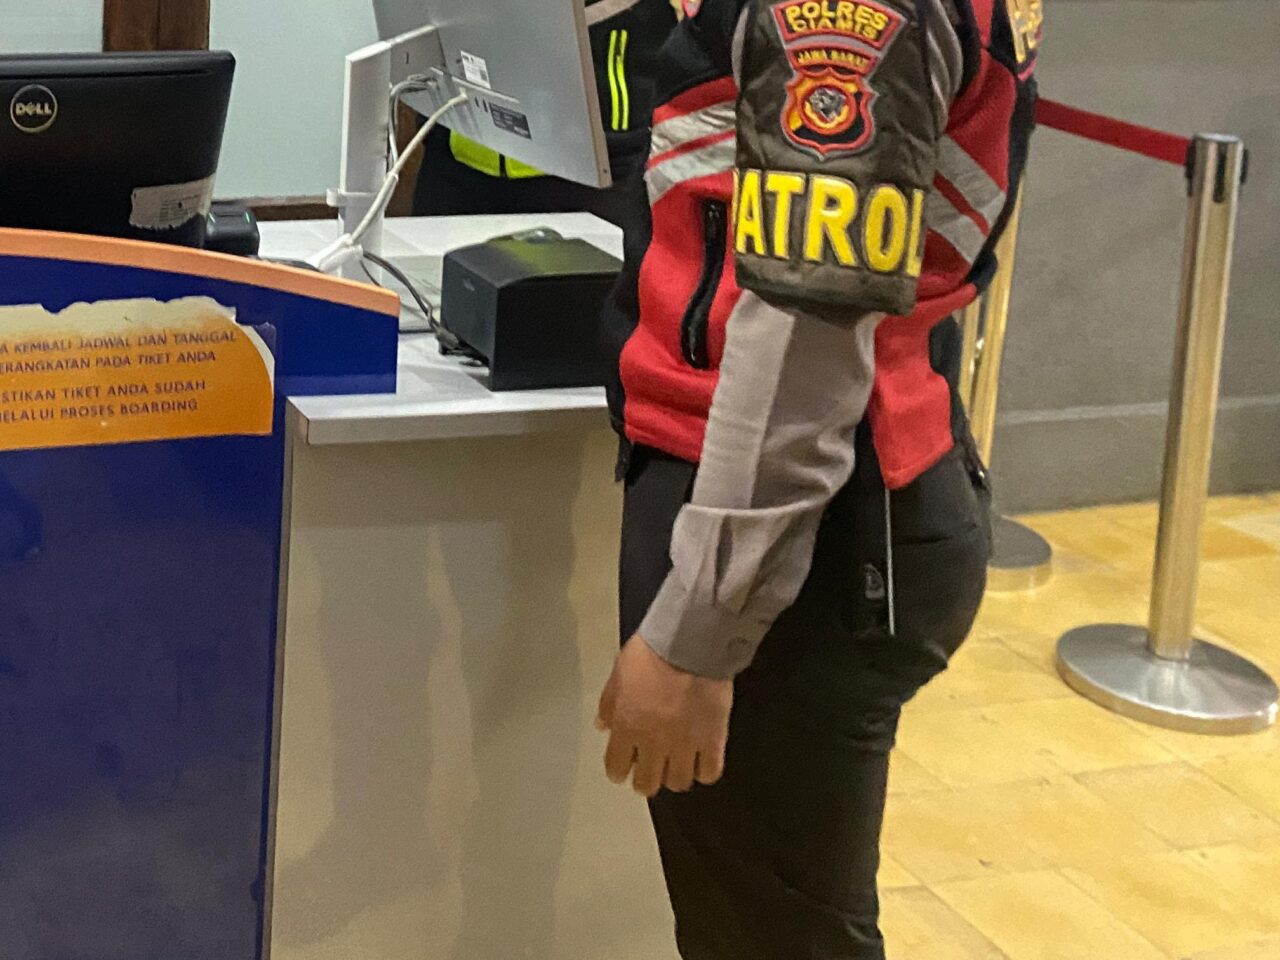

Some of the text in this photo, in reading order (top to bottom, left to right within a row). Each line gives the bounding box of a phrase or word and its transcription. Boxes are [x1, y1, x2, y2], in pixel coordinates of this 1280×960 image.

[784, 0, 890, 31] POLRES
[791, 18, 880, 40] CIAMIS
[15, 100, 53, 116] DELL
[732, 168, 925, 277] ATROL
[14, 340, 72, 354] KEMBALI
[79, 337, 131, 351] JADWAL
[138, 334, 167, 348] DAN
[173, 330, 238, 346] TANGGAL
[95, 355, 131, 368] PADA
[139, 354, 171, 365] TIKET
[176, 350, 217, 363] ANDA
[62, 385, 101, 399] TIKET
[108, 383, 149, 396] ANDA
[154, 380, 206, 394] SUDAH
[60, 404, 115, 418] PROSES
[120, 398, 199, 416] BOARDING
